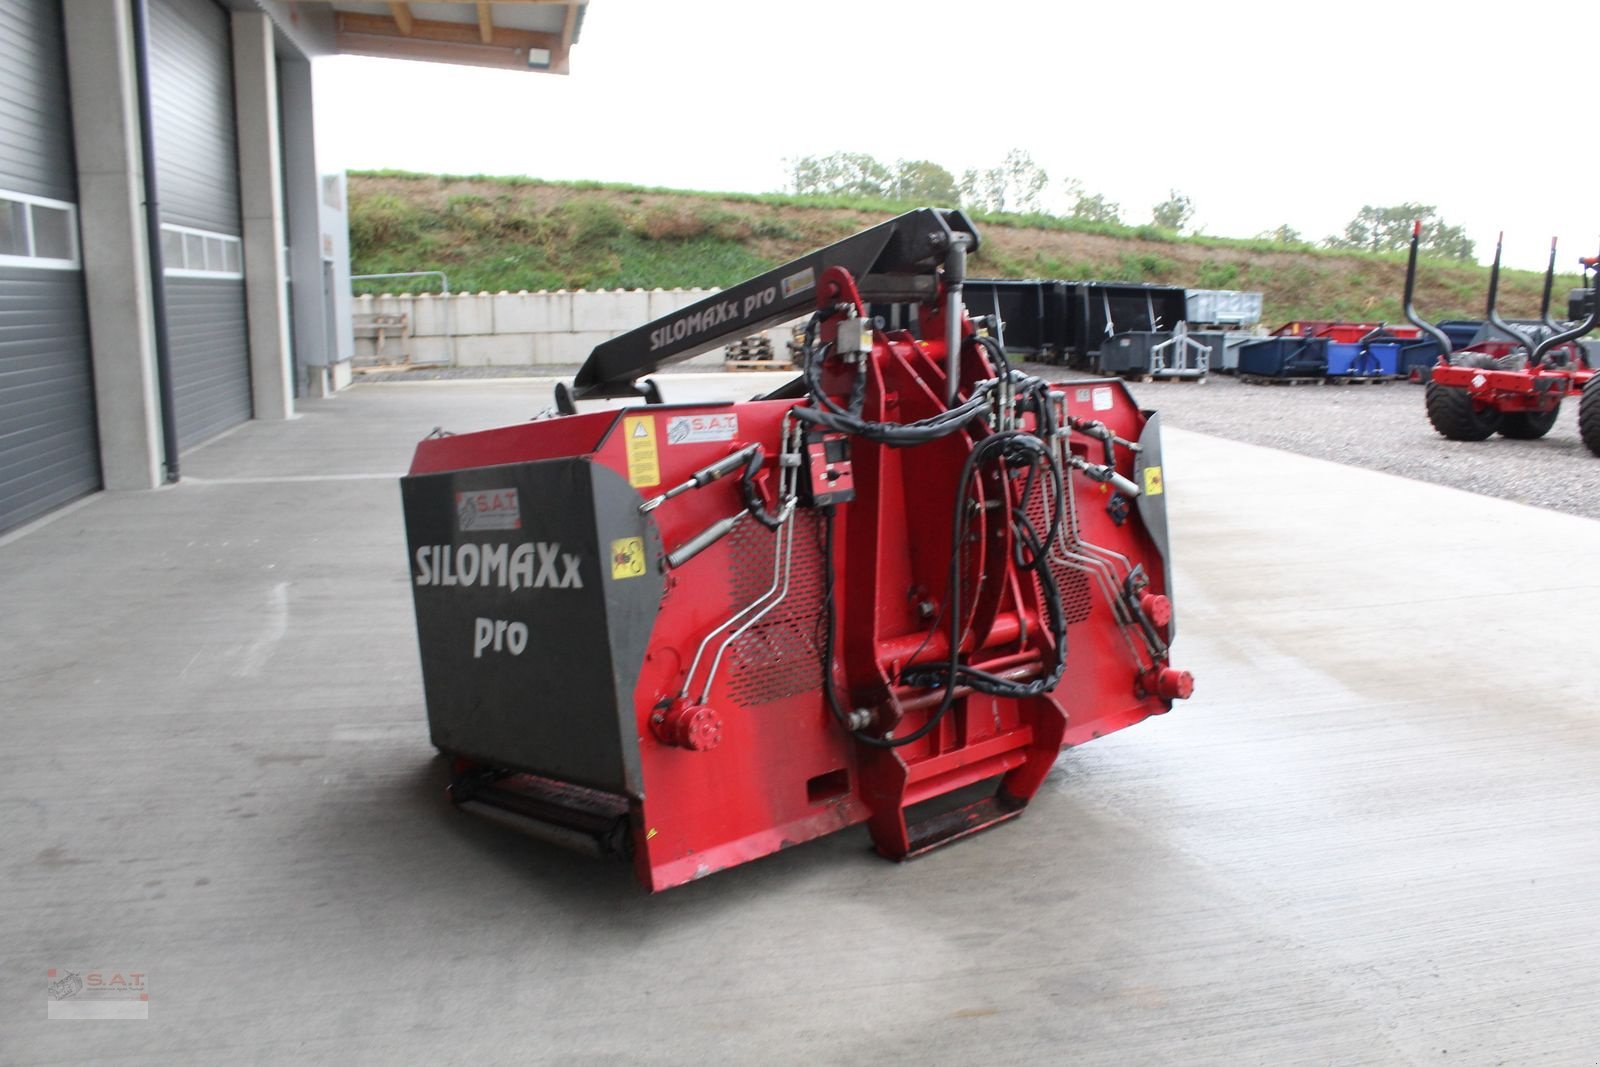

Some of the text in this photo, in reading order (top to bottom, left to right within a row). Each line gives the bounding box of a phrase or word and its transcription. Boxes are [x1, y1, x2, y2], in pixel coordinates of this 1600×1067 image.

[650, 287, 776, 351] SILOMAXx pro
[415, 542, 584, 592] SILOMAXx
[473, 617, 529, 659] pro
